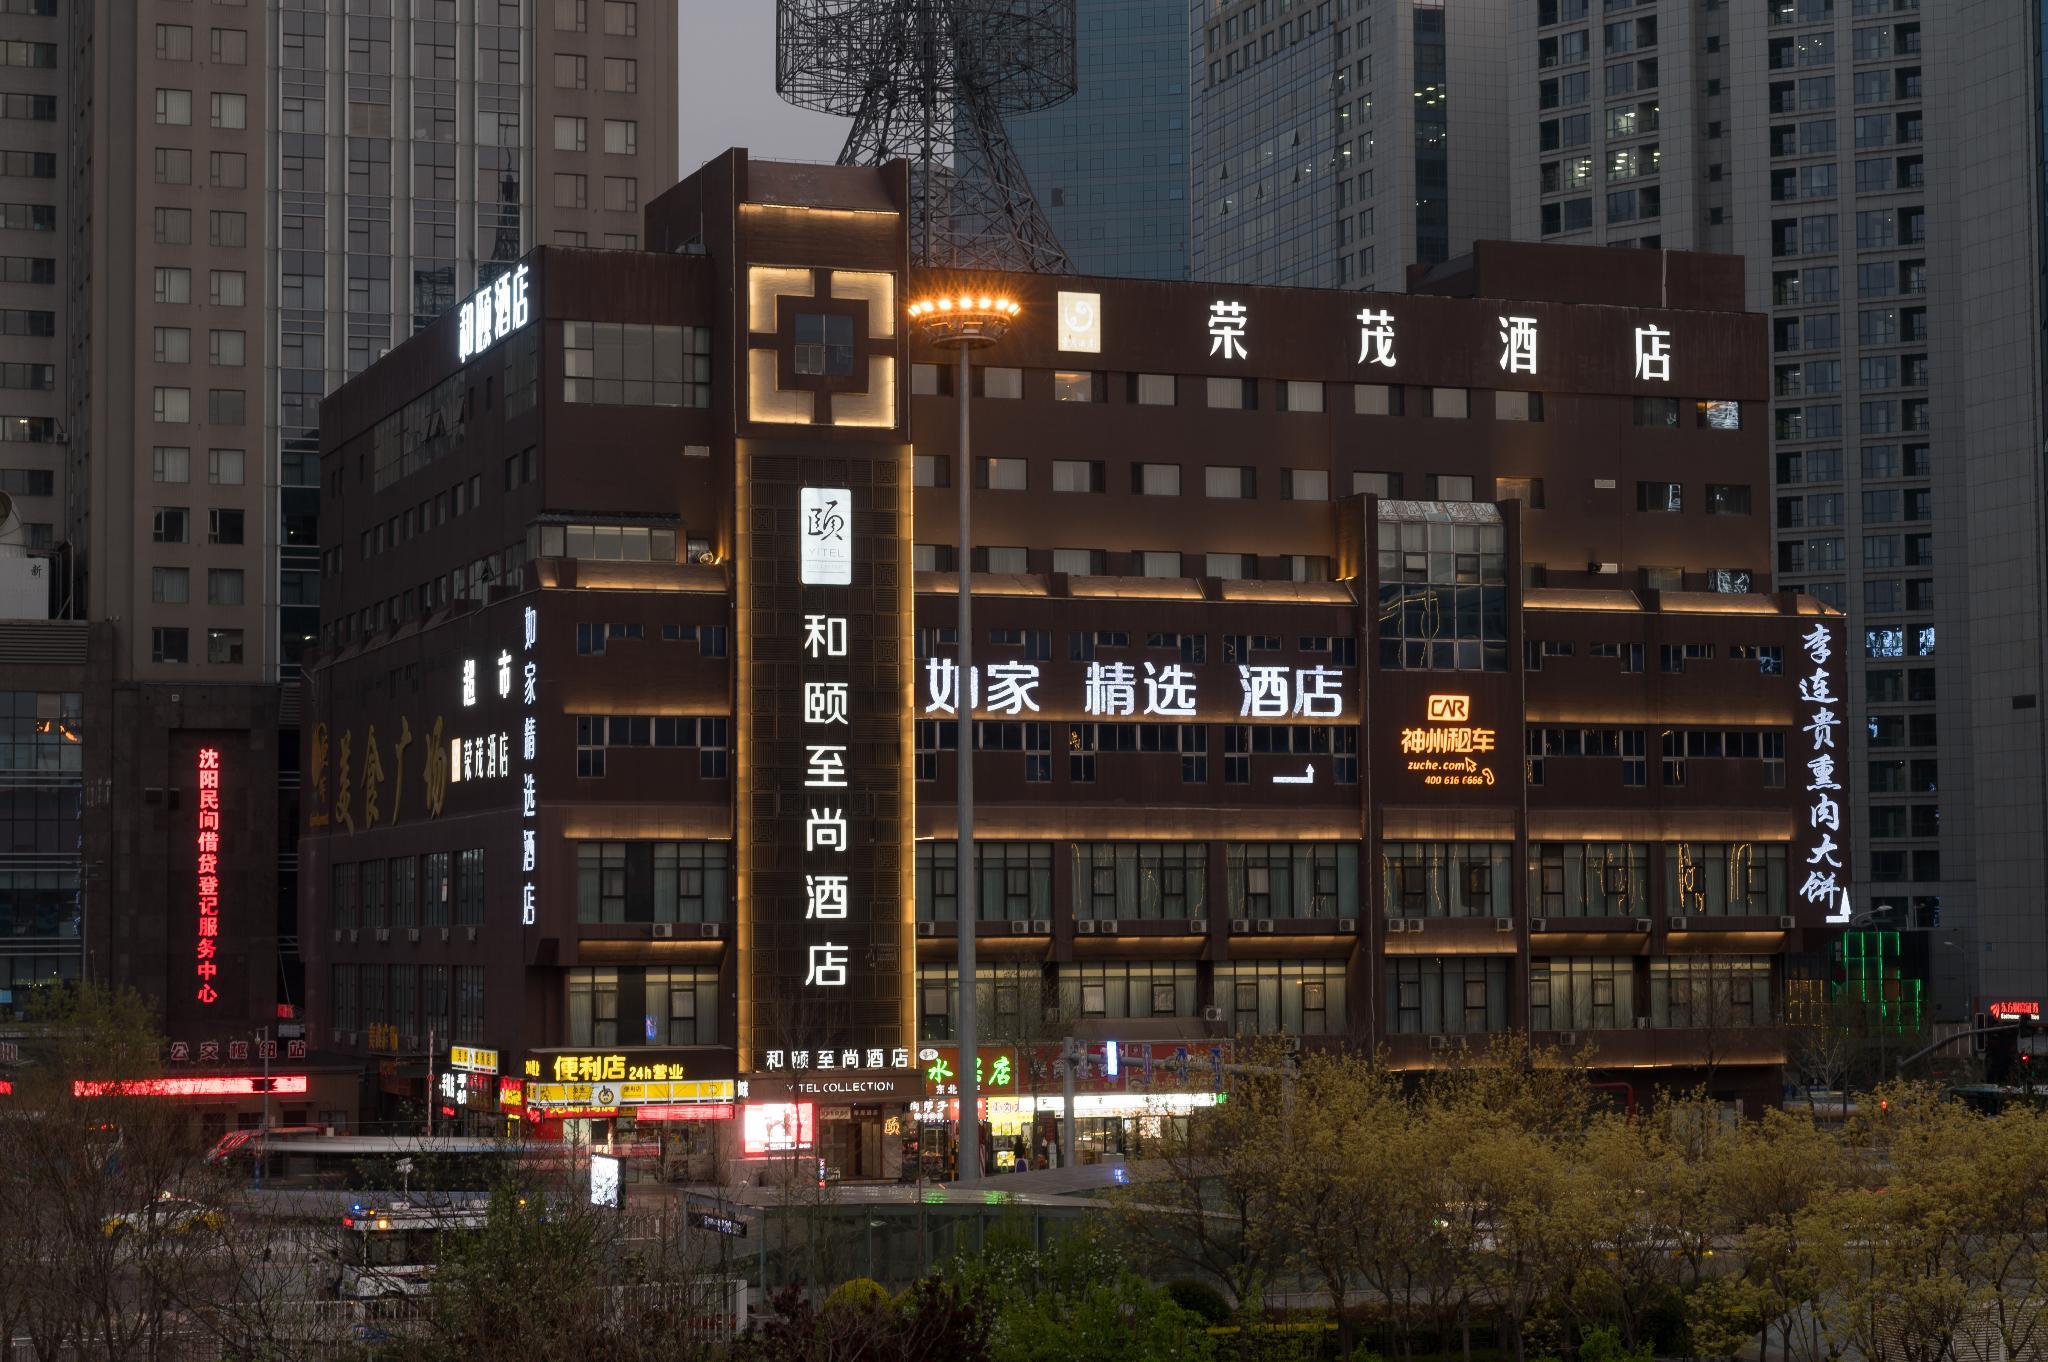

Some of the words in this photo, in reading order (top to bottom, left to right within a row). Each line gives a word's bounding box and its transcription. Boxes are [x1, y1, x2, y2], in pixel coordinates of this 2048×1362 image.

[458, 263, 529, 363] 和颐酒店
[1208, 301, 1670, 382] 荣茂酒店
[463, 649, 512, 707] 超市
[925, 658, 1344, 718] 如家精选酒店
[1431, 699, 1466, 717] CAR
[463, 732, 509, 782] 荣茂酒店
[522, 606, 537, 926] 如家精选酒店
[1401, 727, 1496, 754] 神州租车
[1407, 759, 1465, 771] zuche.com
[1799, 623, 1842, 909] 李连贵熏肉大饼
[335, 715, 448, 836] 美食广场
[805, 614, 849, 986] 和颐至尚酒店
[1425, 776, 1442, 785] 400
[1444, 776, 1460, 785] 616
[197, 748, 220, 1004] 沈阳民间借贷登记服务中心
[554, 1055, 627, 1082] 便利店
[629, 1064, 684, 1081] 24h营业
[766, 1048, 909, 1071] 和颐至尚酒店
[787, 1083, 820, 1093] YTEL
[822, 1081, 894, 1093] COLLECTION
